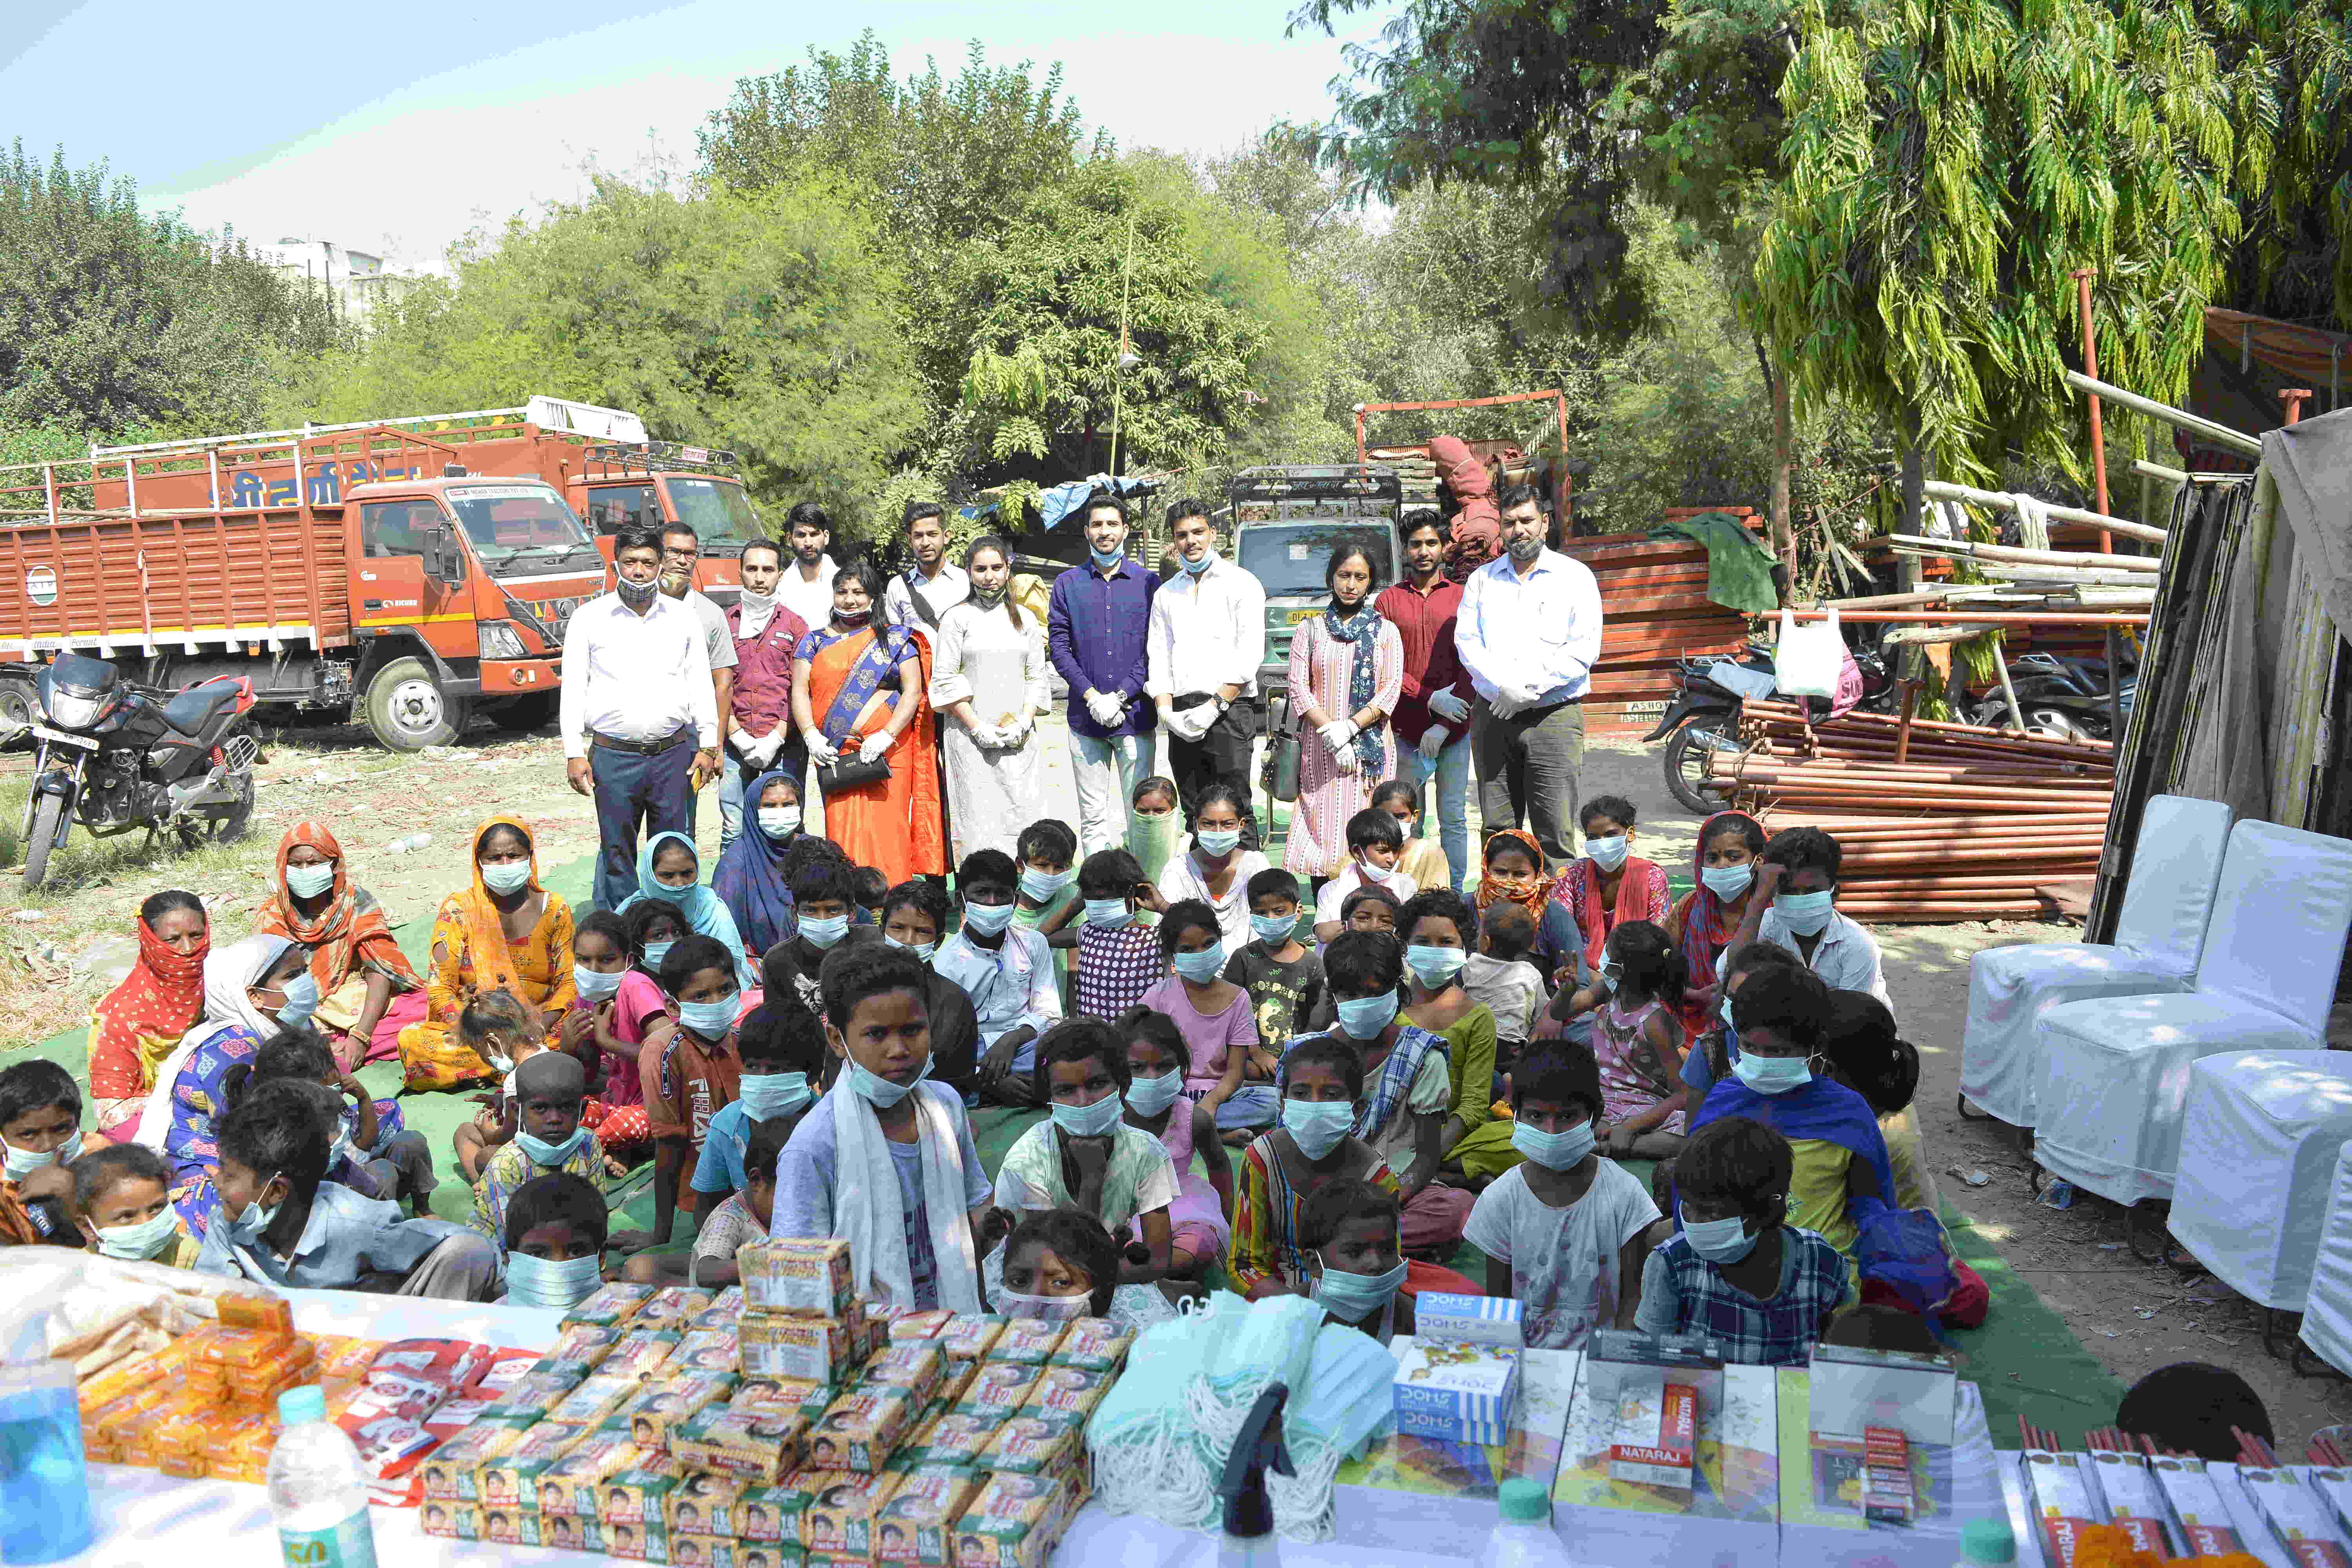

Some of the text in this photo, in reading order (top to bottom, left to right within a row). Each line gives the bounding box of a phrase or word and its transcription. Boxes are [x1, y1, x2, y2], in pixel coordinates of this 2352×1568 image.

[1426, 1294, 1475, 1308] DOMS
[1419, 1317, 1471, 1330] DOMS
[1401, 1388, 1451, 1405] DOMS
[1405, 1411, 1455, 1429] DOMS
[1621, 1446, 1681, 1462] NATARAJ
